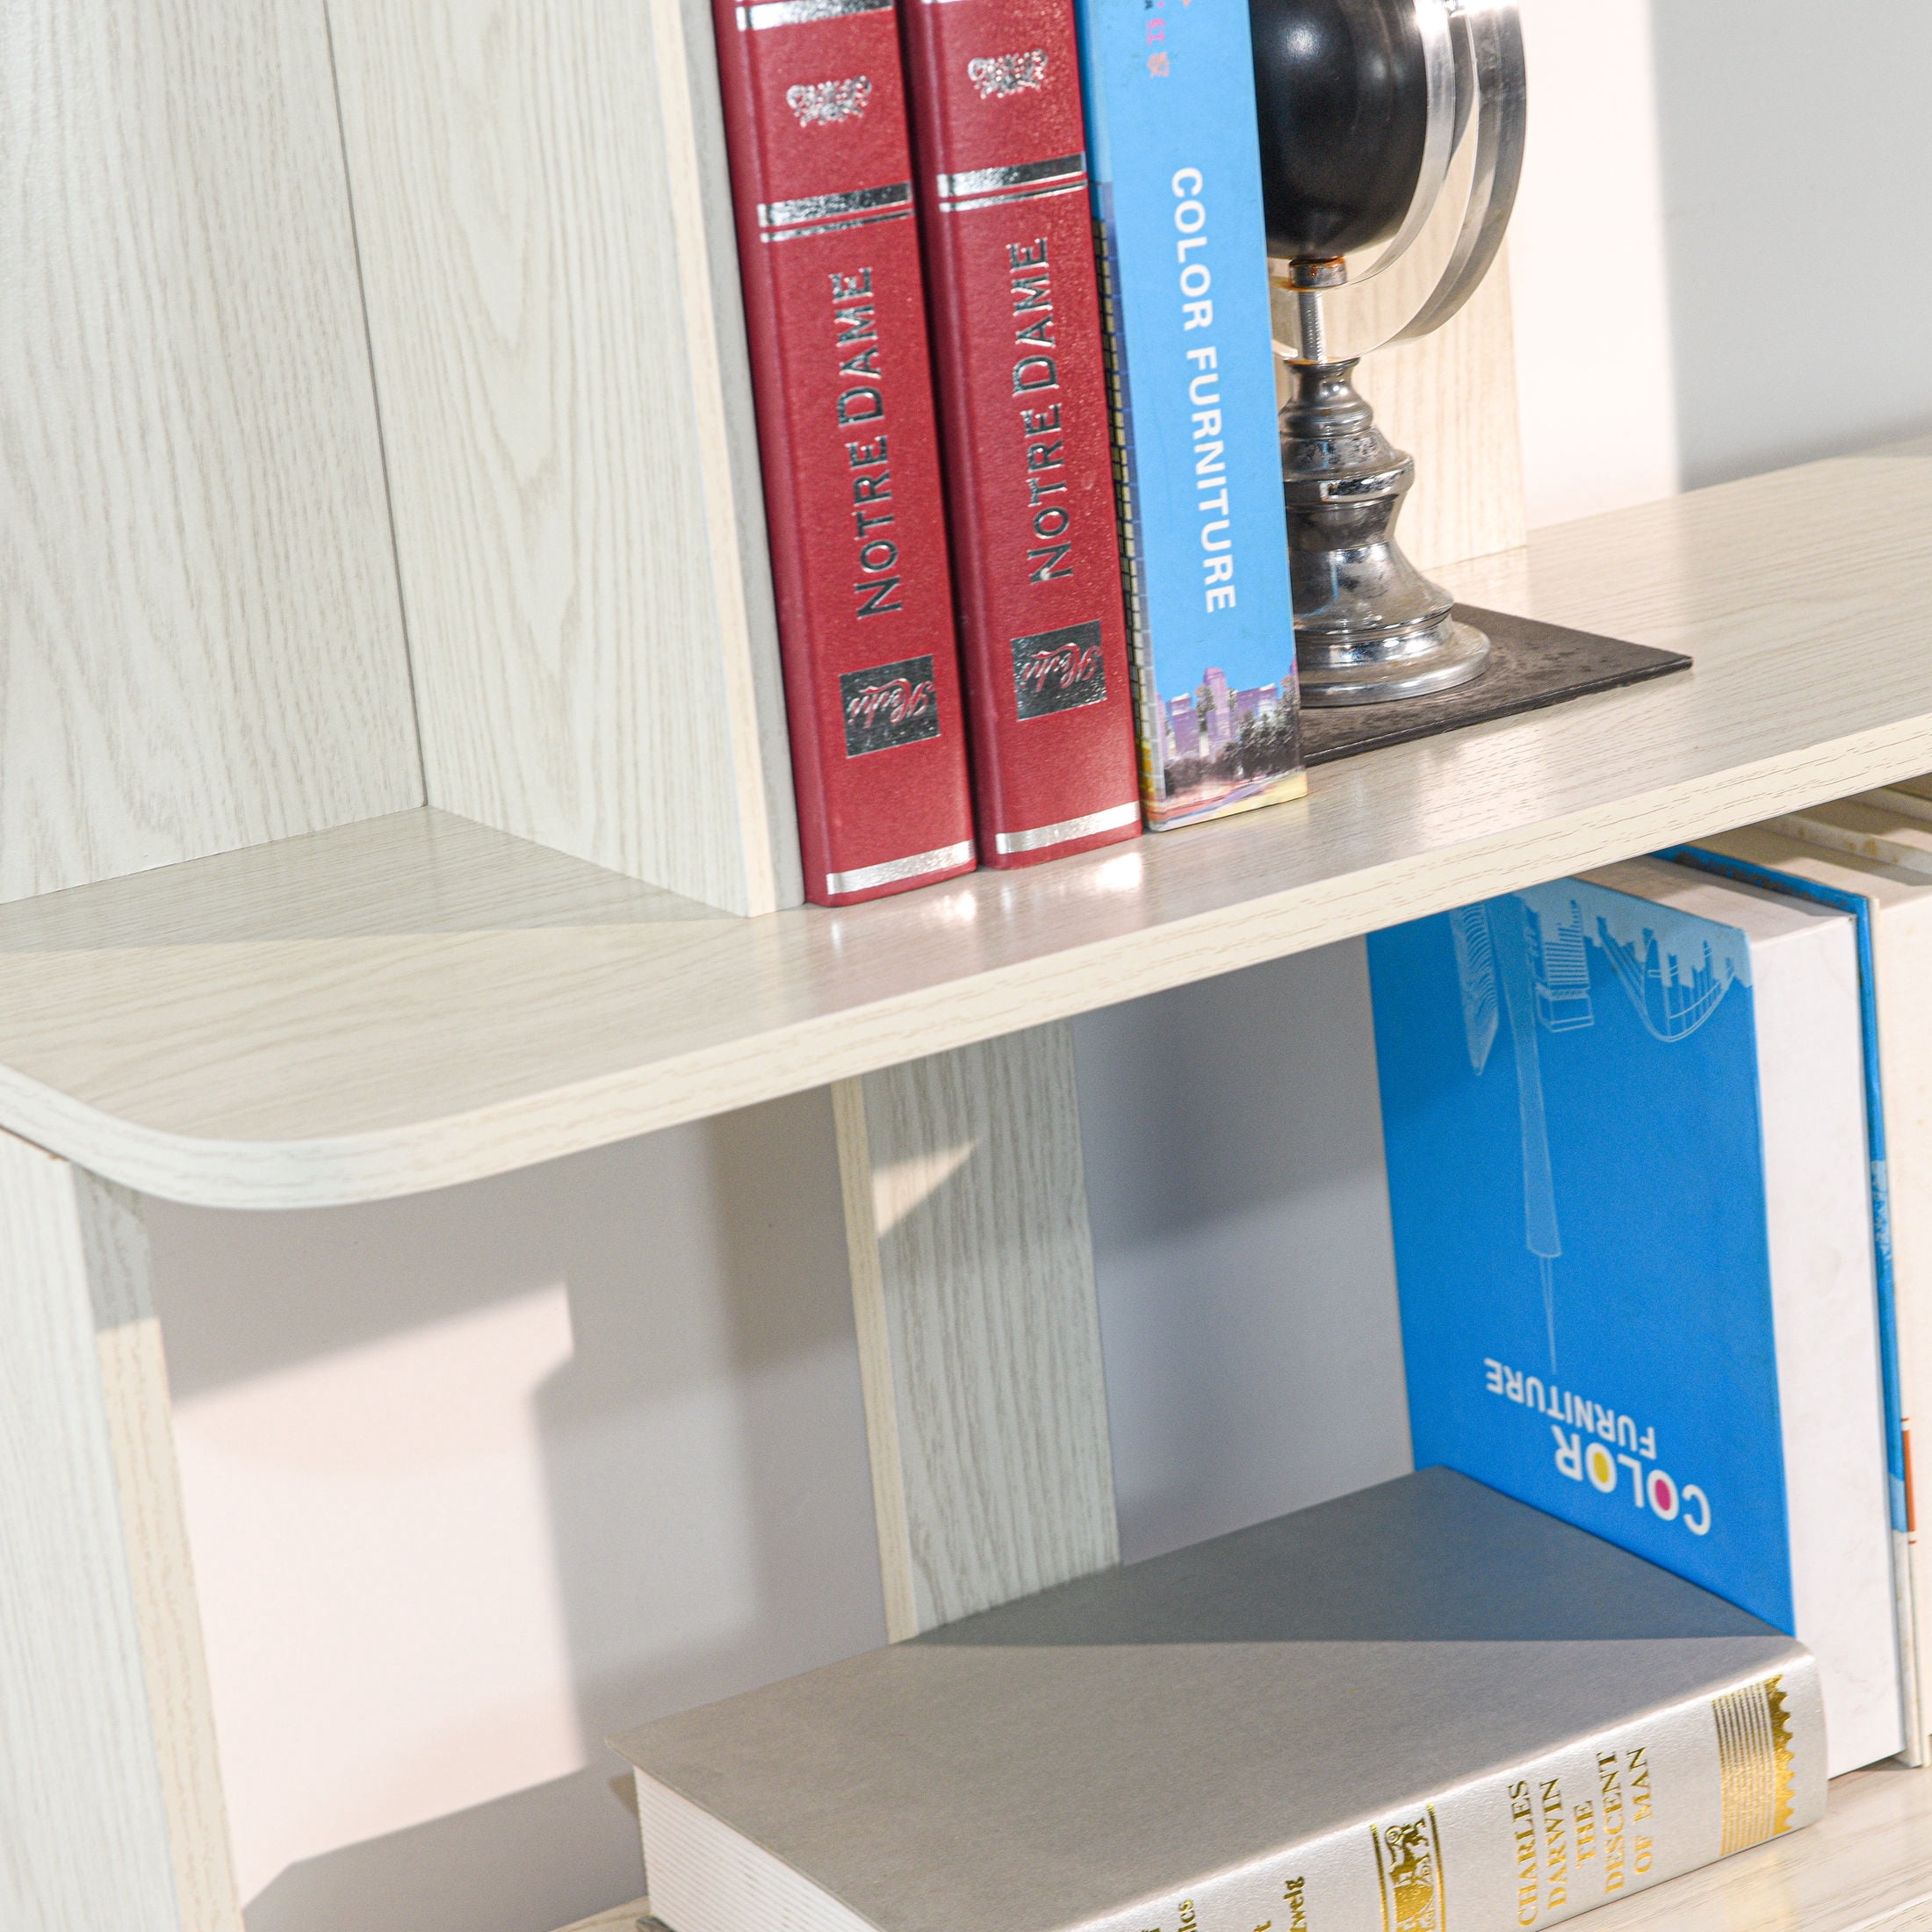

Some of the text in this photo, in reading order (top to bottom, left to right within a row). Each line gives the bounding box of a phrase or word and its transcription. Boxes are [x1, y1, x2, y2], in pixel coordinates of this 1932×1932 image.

[828, 267, 902, 620] NOTRE DAME
[1005, 237, 1073, 585] NOTRE DAME
[1171, 167, 1236, 613] COLOR FURNITURE
[1483, 1357, 1657, 1460] FURNITURE
[1551, 1424, 1712, 1536] COLOR
[1508, 1780, 1538, 1927] CHARLES
[1540, 1778, 1568, 1910] DARWIN
[1574, 1800, 1596, 1869] THE
[1597, 1752, 1624, 1895] DESCENT
[1626, 1747, 1654, 1874] OF MAN
